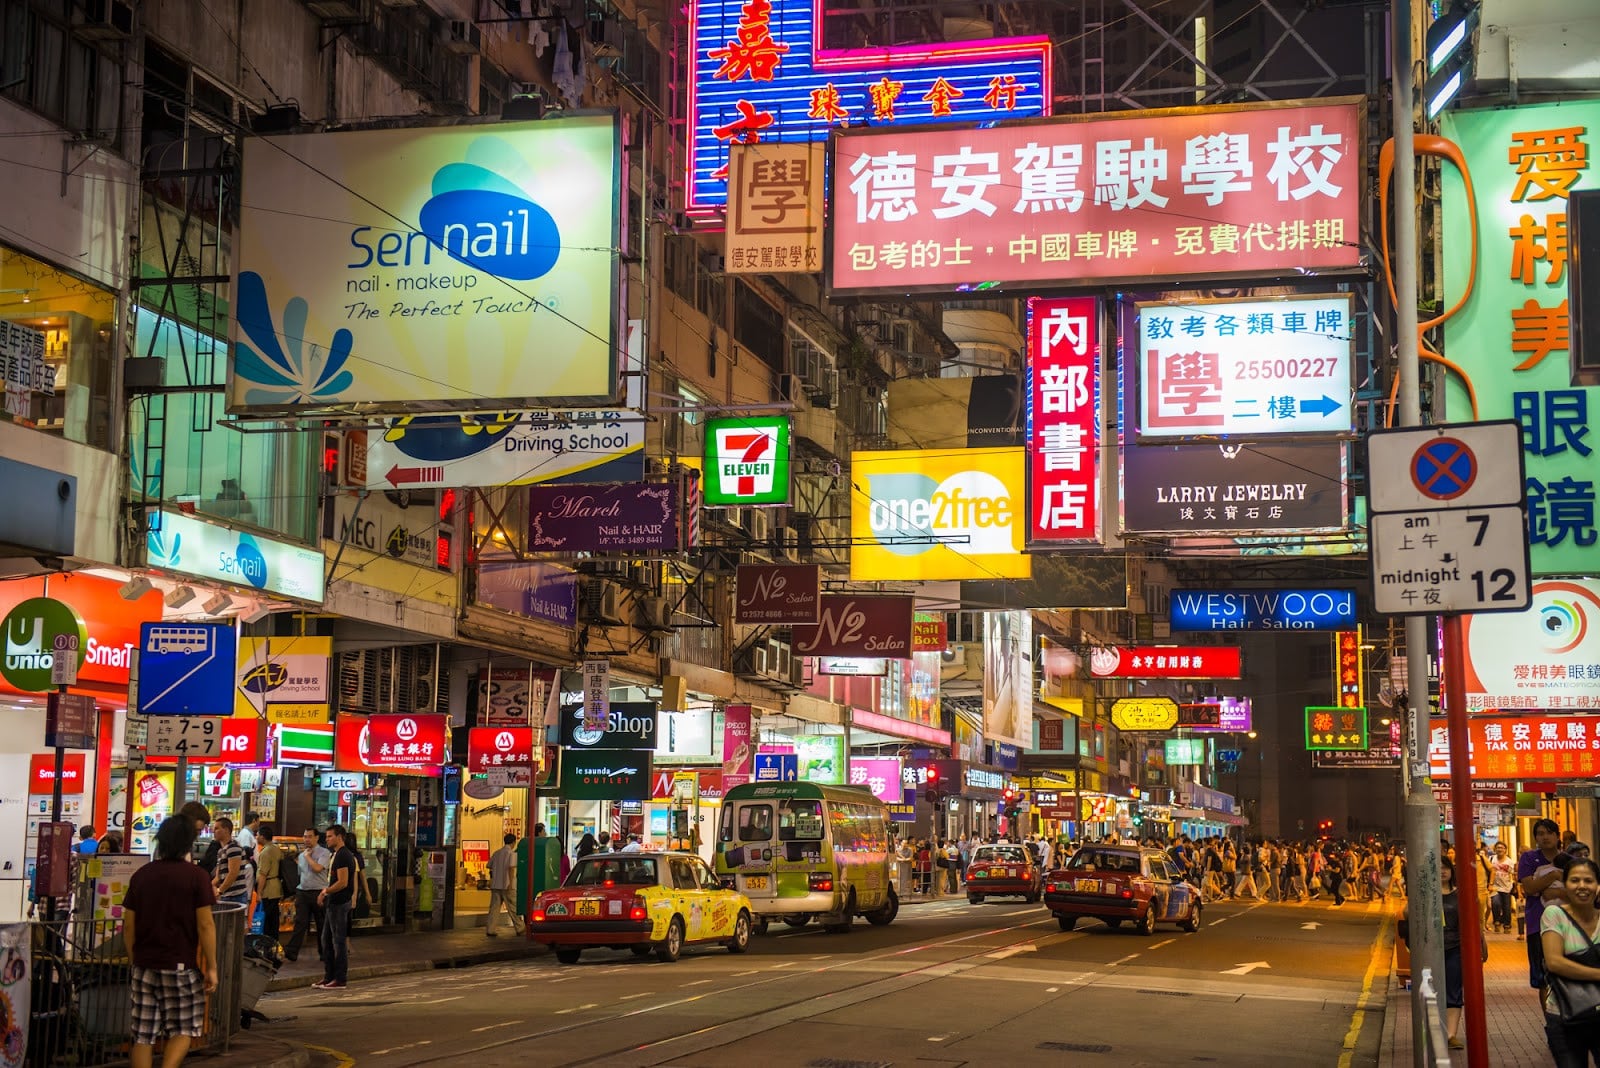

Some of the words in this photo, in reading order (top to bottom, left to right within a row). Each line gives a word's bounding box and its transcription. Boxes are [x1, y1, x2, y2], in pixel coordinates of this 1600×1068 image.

[808, 76, 1026, 122] 珠寶金行
[848, 124, 1343, 224] 德安駕駛學校
[749, 158, 810, 225] 學
[731, 246, 817, 269] 德安駕駛學校
[346, 275, 380, 293] nail
[397, 272, 477, 292] makeup
[344, 302, 380, 319] The
[390, 300, 464, 317] Perfect
[473, 296, 541, 314] Touch
[1235, 358, 1339, 381] 25500227
[1161, 350, 1223, 416] 學
[1232, 395, 1297, 420] 二樓
[1039, 308, 1089, 530] 內部書店
[505, 435, 564, 453] Driving
[569, 432, 629, 451] School
[725, 433, 770, 497] 7
[1156, 486, 1219, 504] LARRY
[1223, 483, 1308, 503] JEWELRY
[548, 495, 622, 519] March
[869, 487, 1012, 531] one2free
[341, 514, 376, 549] MEG
[599, 525, 619, 536] Nail
[621, 525, 631, 535] &
[633, 523, 663, 535] HAIR
[1404, 516, 1430, 528] am
[1466, 515, 1490, 547] 7
[1398, 533, 1439, 551] 上午
[1381, 567, 1461, 585] midnight
[1471, 568, 1517, 602] 12
[740, 569, 787, 606] N2
[786, 591, 815, 604] Salon
[1401, 588, 1442, 606] 午夜
[797, 602, 866, 651] N2
[914, 624, 938, 634] Nail
[1212, 617, 1253, 629] Hair
[1261, 617, 1316, 629] Salon
[864, 635, 905, 652] Salon
[914, 635, 939, 645] Box
[280, 685, 299, 693] Driving
[156, 725, 173, 735] 上午
[606, 711, 653, 740] Shop
[156, 743, 172, 753] 下午
[379, 743, 433, 755] 永隆銀行
[1485, 741, 1508, 751] TAK
[1513, 741, 1531, 750] ON
[1537, 740, 1587, 750] DRIVING
[479, 752, 528, 765] 永隆銀行
[584, 767, 610, 775] saunda
[850, 766, 886, 796] 莎莎
